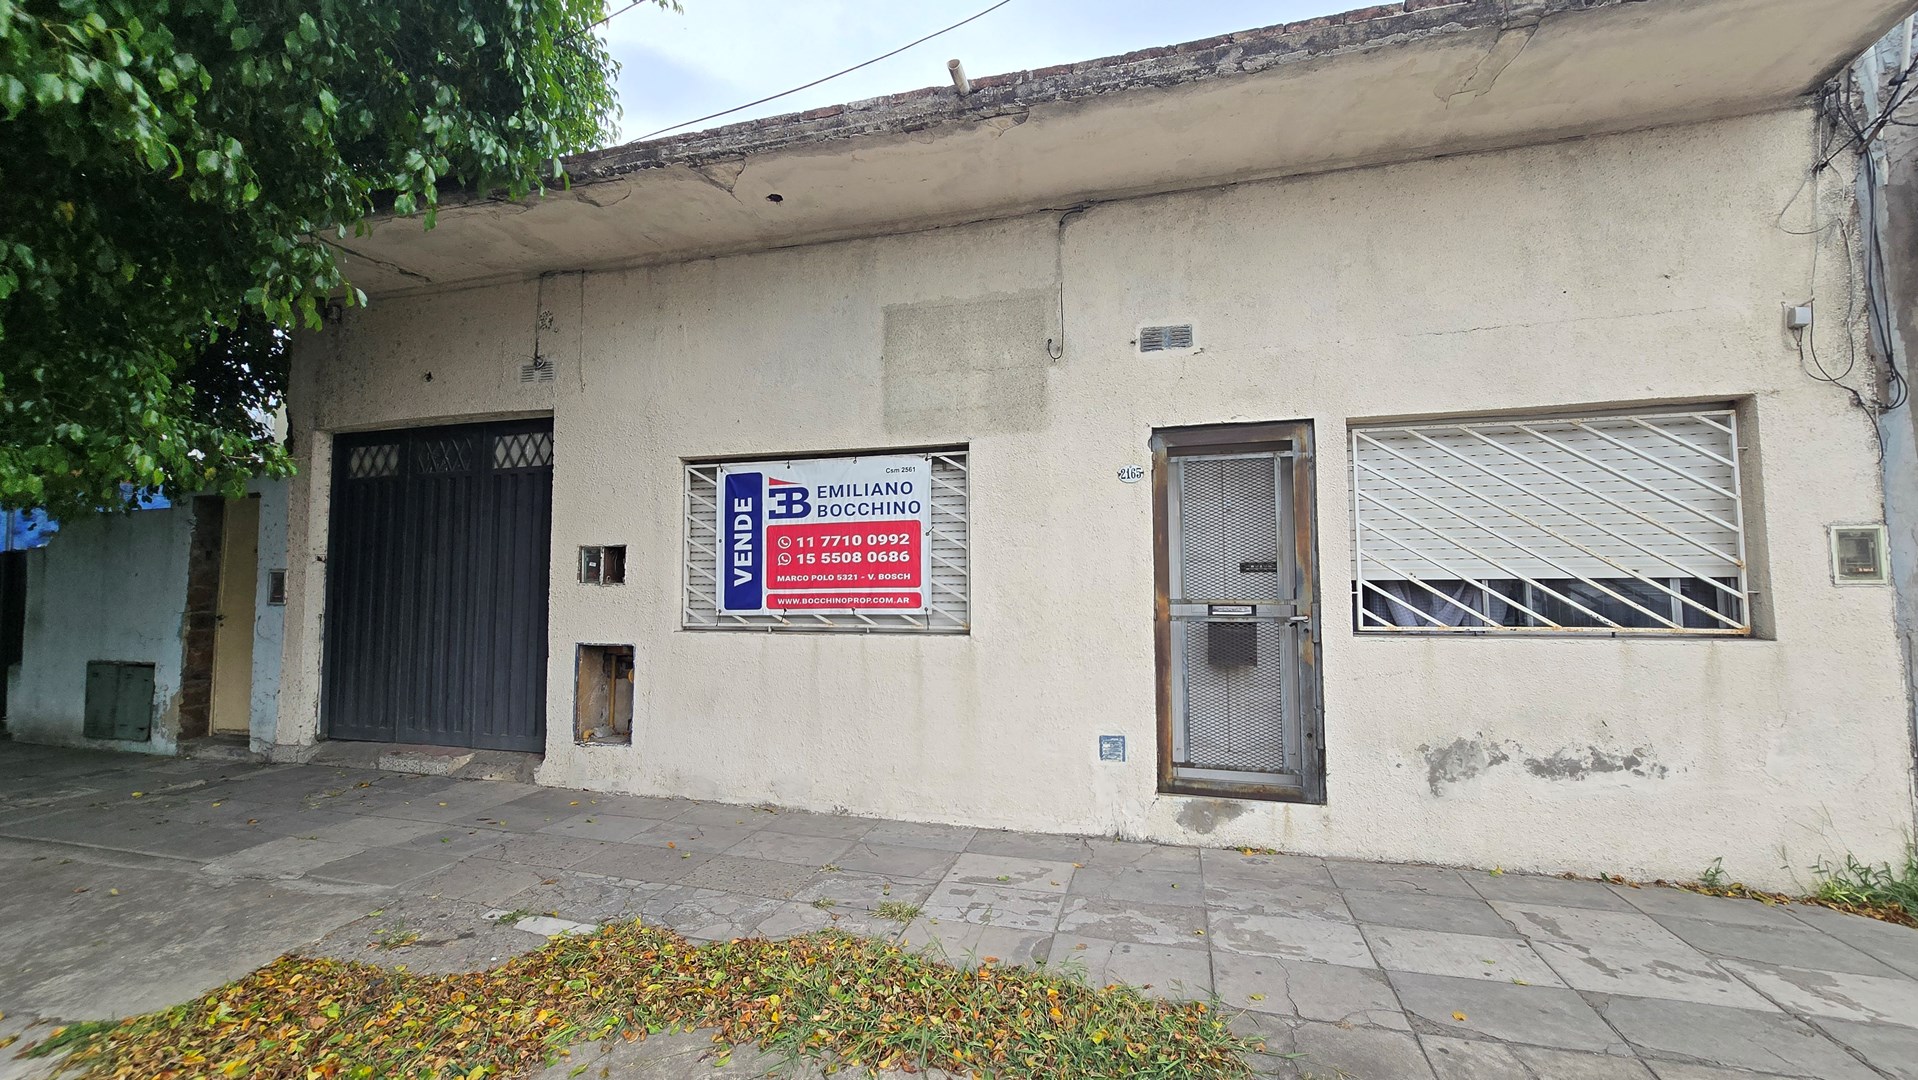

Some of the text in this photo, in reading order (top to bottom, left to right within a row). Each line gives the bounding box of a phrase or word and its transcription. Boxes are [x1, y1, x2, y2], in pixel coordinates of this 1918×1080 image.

[1120, 467, 1142, 480] 2165
[817, 481, 913, 499] EMILIANO
[817, 500, 921, 518] BOCCHINO
[733, 497, 753, 587] VENDE
[796, 533, 910, 548] 11 7710 0992
[796, 550, 910, 565] 15 5508 0686
[777, 574, 809, 582] MARCO
[836, 573, 858, 581] 5321
[777, 597, 910, 605] WWW.BOCCHINOPROP.COM.AR
